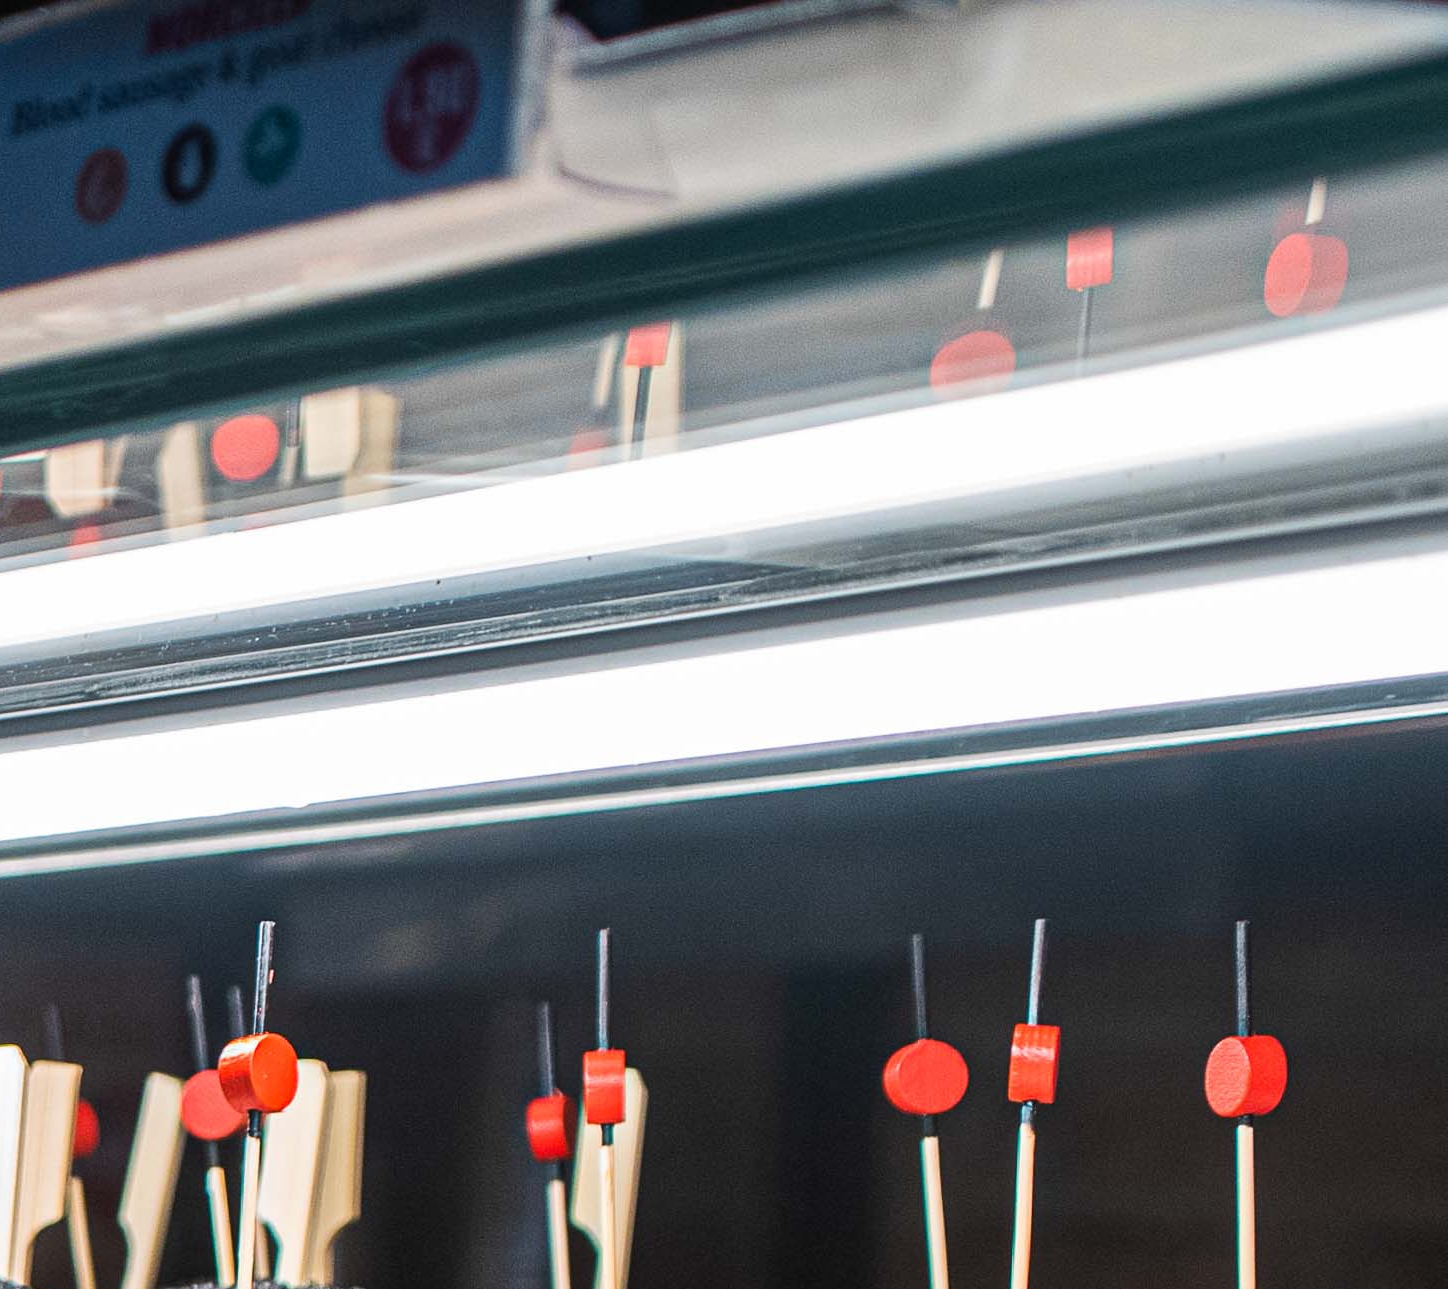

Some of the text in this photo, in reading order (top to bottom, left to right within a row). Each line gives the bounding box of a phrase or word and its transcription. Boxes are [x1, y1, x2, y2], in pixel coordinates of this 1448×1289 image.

[11, 85, 91, 136] Blood
[99, 62, 209, 115] sausage
[218, 49, 238, 82] &
